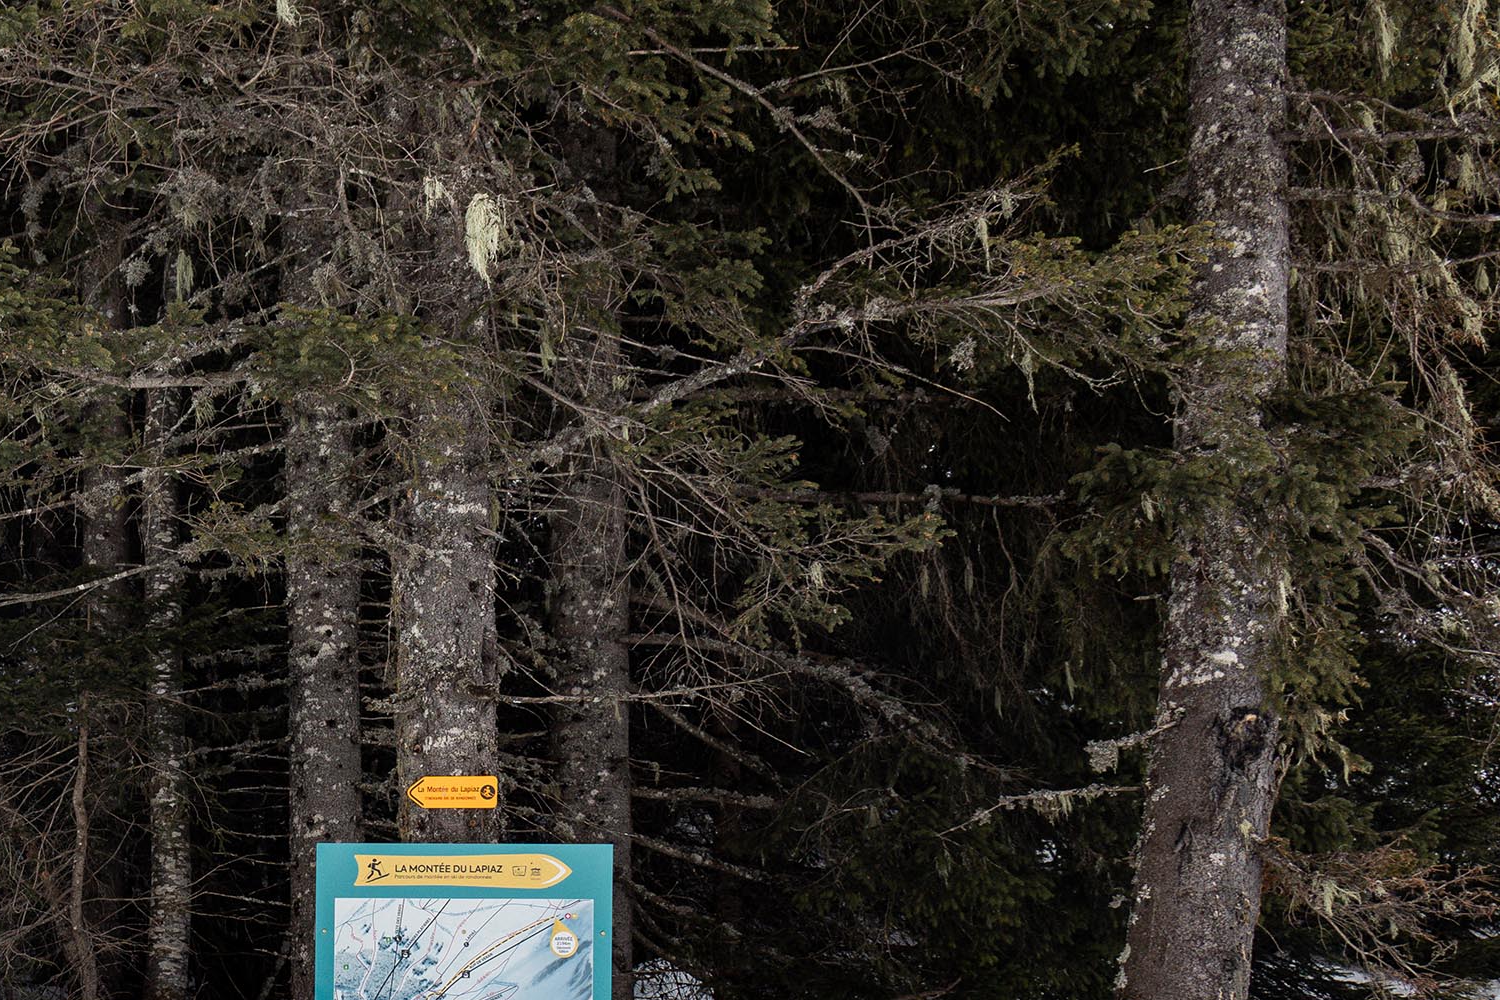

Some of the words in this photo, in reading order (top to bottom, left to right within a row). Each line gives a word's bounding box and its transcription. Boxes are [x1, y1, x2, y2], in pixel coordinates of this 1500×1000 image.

[395, 865, 407, 873] LA
[409, 863, 451, 873] MONTÉE
[469, 865, 503, 873] LAPIAZ
